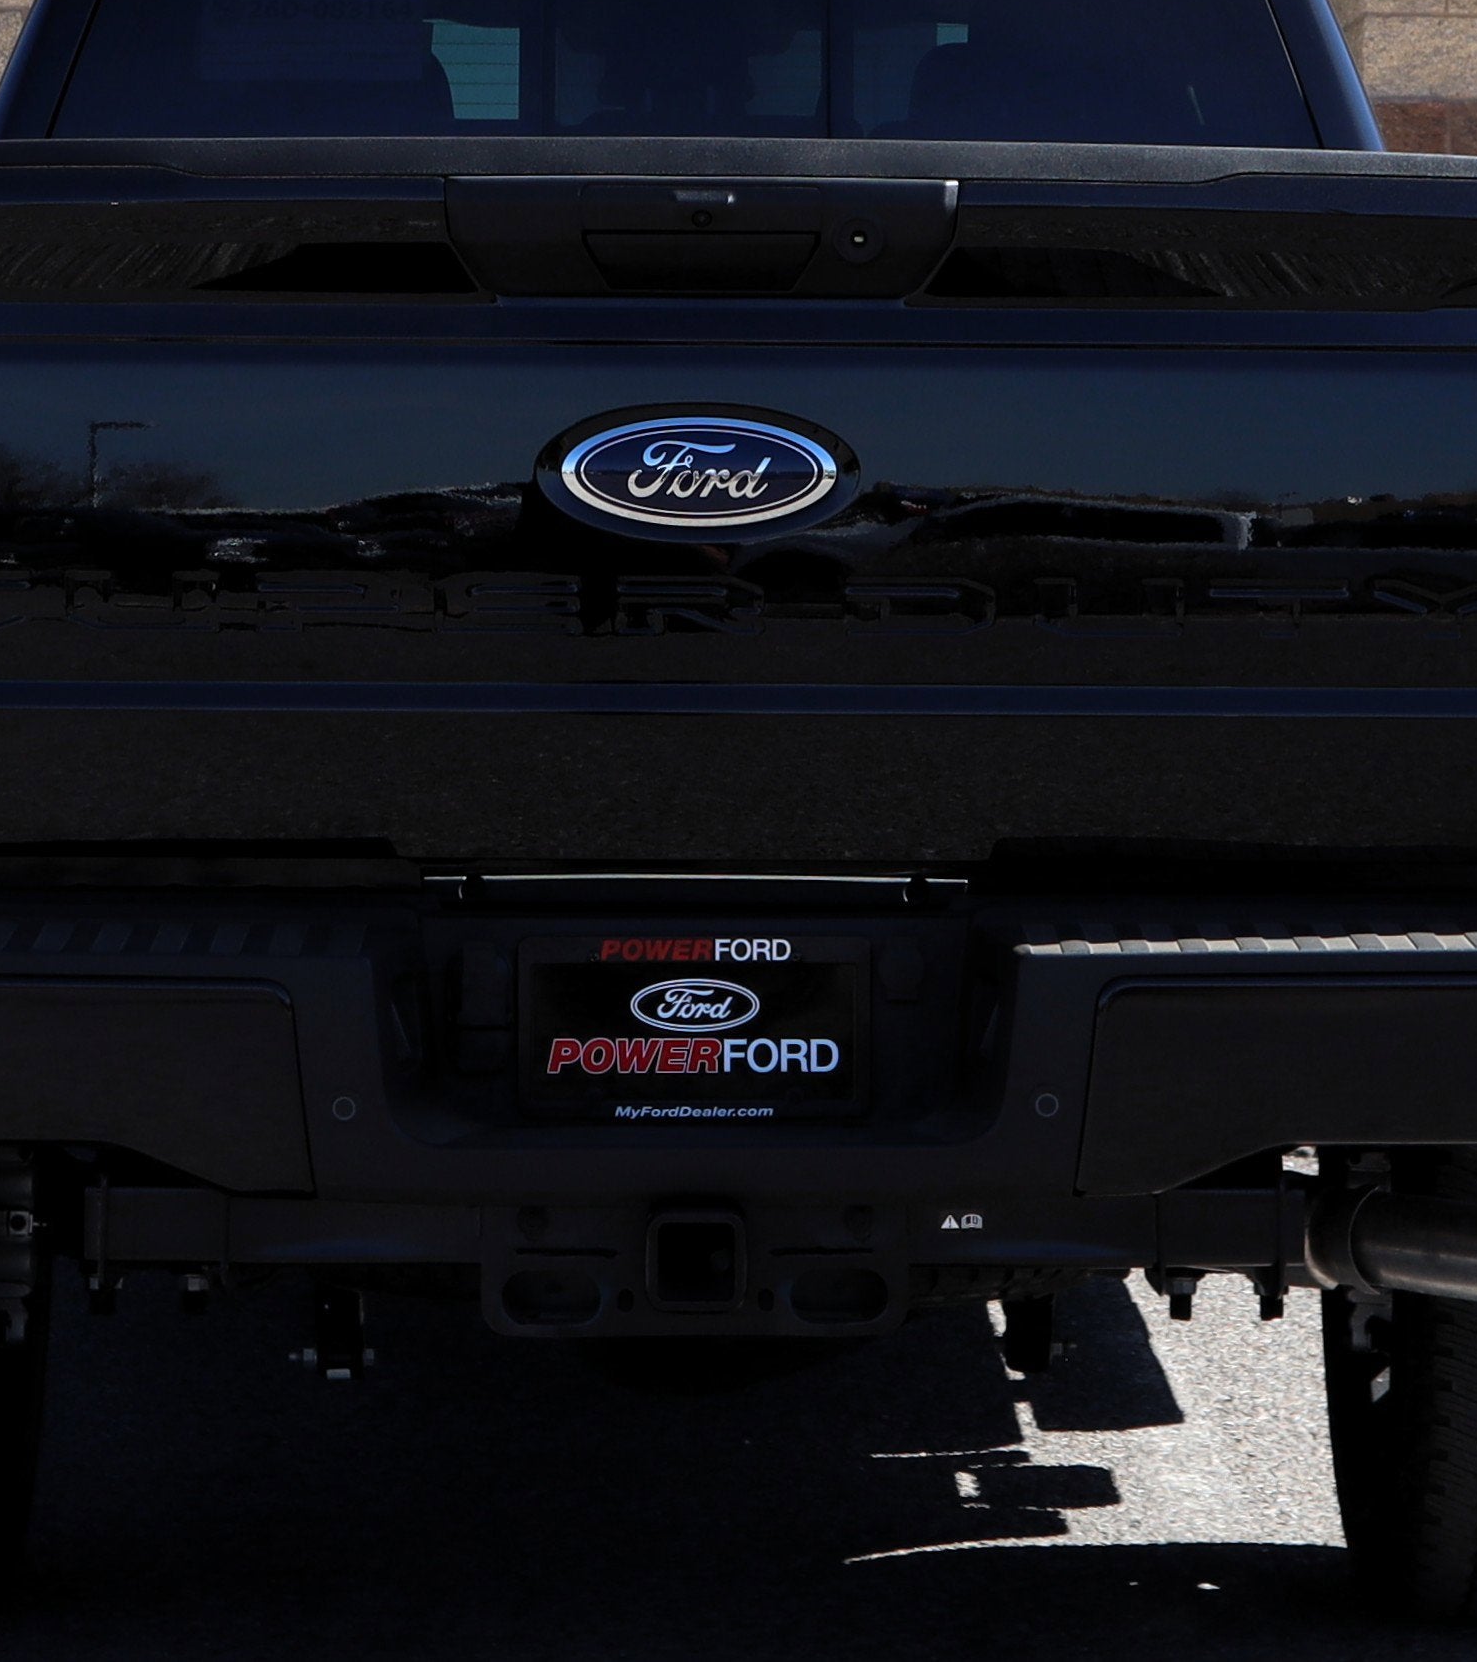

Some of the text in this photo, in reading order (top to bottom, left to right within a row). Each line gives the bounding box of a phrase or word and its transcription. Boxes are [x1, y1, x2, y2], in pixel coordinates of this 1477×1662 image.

[627, 440, 772, 499] Ford
[656, 988, 733, 1020] Ford
[615, 1105, 774, 1119] MyFordDealer.com
